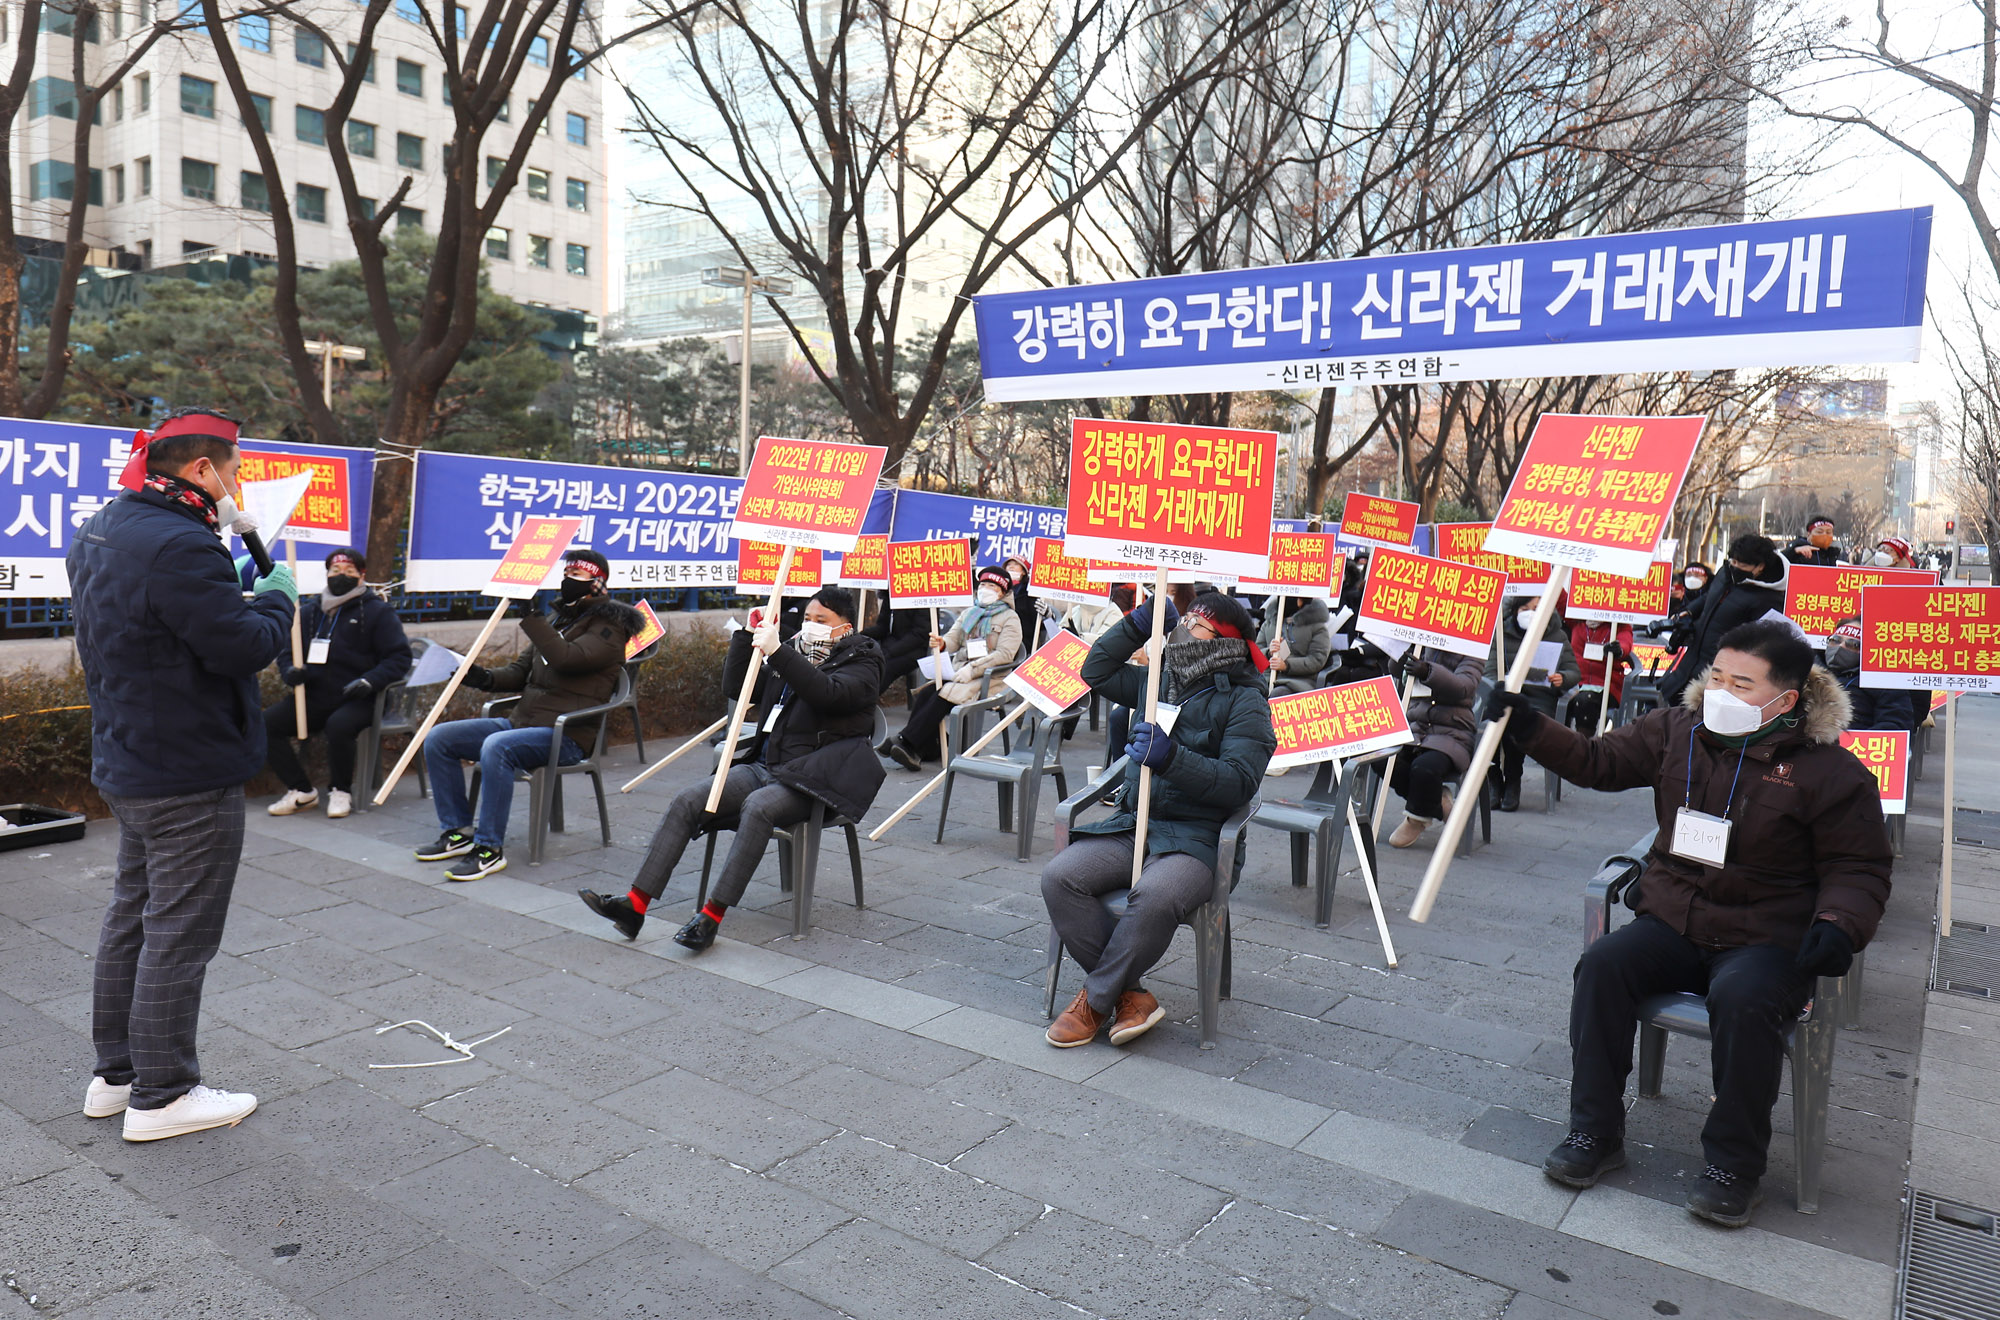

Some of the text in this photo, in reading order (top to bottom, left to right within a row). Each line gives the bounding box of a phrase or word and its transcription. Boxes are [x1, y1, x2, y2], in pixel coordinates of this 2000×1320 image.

[1012, 233, 1847, 363] 강력히 요구한다! 신라젠 거래재개!
[1581, 424, 1644, 461] 신라젠!
[766, 445, 869, 476] 2022년 1월18일!
[1082, 429, 1262, 489] 강력하게 요구한다!
[479, 473, 627, 513] 한국거래소!
[772, 474, 846, 501] 기업심사위원회!
[1524, 462, 1673, 505] 경영투명성, 재무건전성
[308, 495, 342, 524] 원한다!
[744, 496, 860, 528] 신라젠 거래재개 결정하라!
[970, 504, 1034, 534] 부당하다!
[1086, 480, 1245, 539] 신라젠 거래재개!
[1504, 498, 1661, 545] 기업지속성, 다 충족했다!
[1345, 521, 1362, 533] 신라젠
[893, 543, 966, 569] 신라젠 거래재개!
[1117, 544, 1155, 561] -신라젠
[1158, 548, 1208, 566] 주주연합-
[1275, 537, 1325, 559] 17만소액주주!
[893, 571, 929, 594] 강력하게
[930, 569, 968, 593] 촉구한다!
[1276, 560, 1327, 582] 강력히 원한다!
[1375, 554, 1429, 589] 2022년
[1430, 566, 1462, 596] 새해
[1461, 573, 1498, 604] 소망!
[1372, 584, 1420, 621] 신라젠
[1420, 595, 1489, 636] 거래재개!
[1573, 585, 1664, 611] 강력하게 촉구한다!
[1795, 593, 1856, 615] 경영투명성,
[1925, 592, 1986, 617] 신라젠!
[1874, 621, 1955, 645] 경영투명성,
[1869, 648, 1949, 672] 기업지속성,
[1953, 650, 1970, 671] 다
[1907, 676, 1992, 688] -신라젠 주주연합-
[1332, 684, 1381, 714] 살길이다!
[1298, 716, 1345, 745] 거래재개
[1343, 706, 1395, 737] 촉구한다!
[1846, 736, 1896, 762] 소망!
